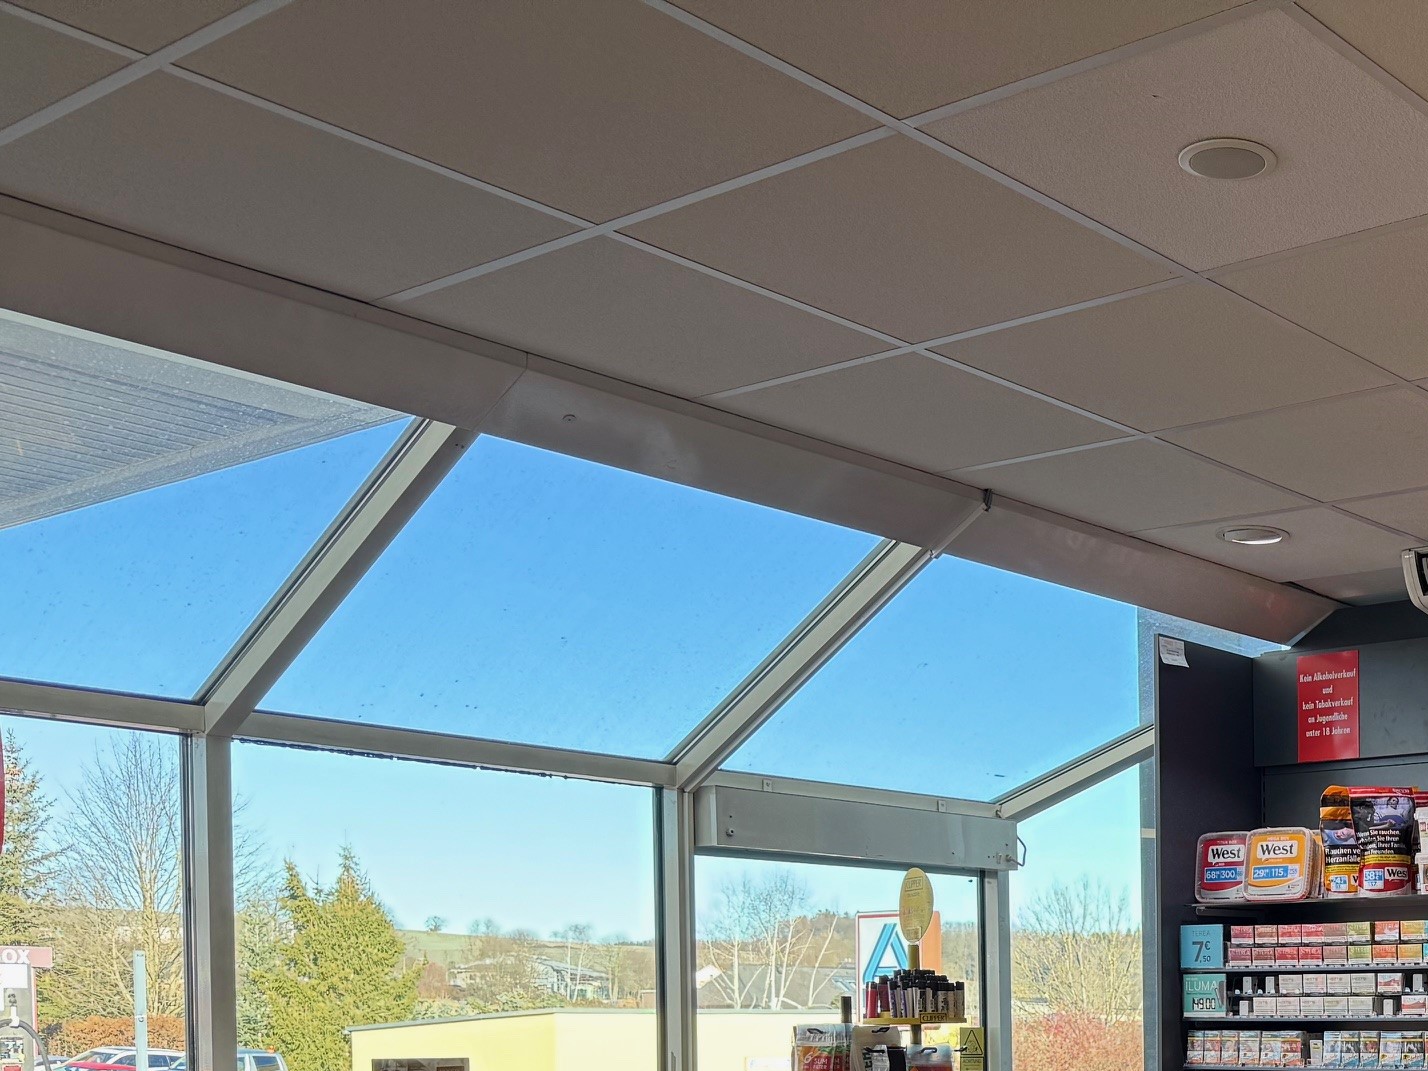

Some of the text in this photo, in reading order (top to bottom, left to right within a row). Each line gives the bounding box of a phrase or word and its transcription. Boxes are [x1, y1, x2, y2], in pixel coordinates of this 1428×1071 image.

[1313, 669, 1356, 681] Alkoholverkauf
[1323, 685, 1332, 694] und
[1303, 697, 1353, 710] kein Tabakverkauf
[1317, 712, 1347, 724] Jugendliche
[1306, 729, 1320, 737] unter
[1211, 848, 1241, 859] West
[1261, 843, 1294, 855] West
[1185, 981, 1216, 991] ILUMA
